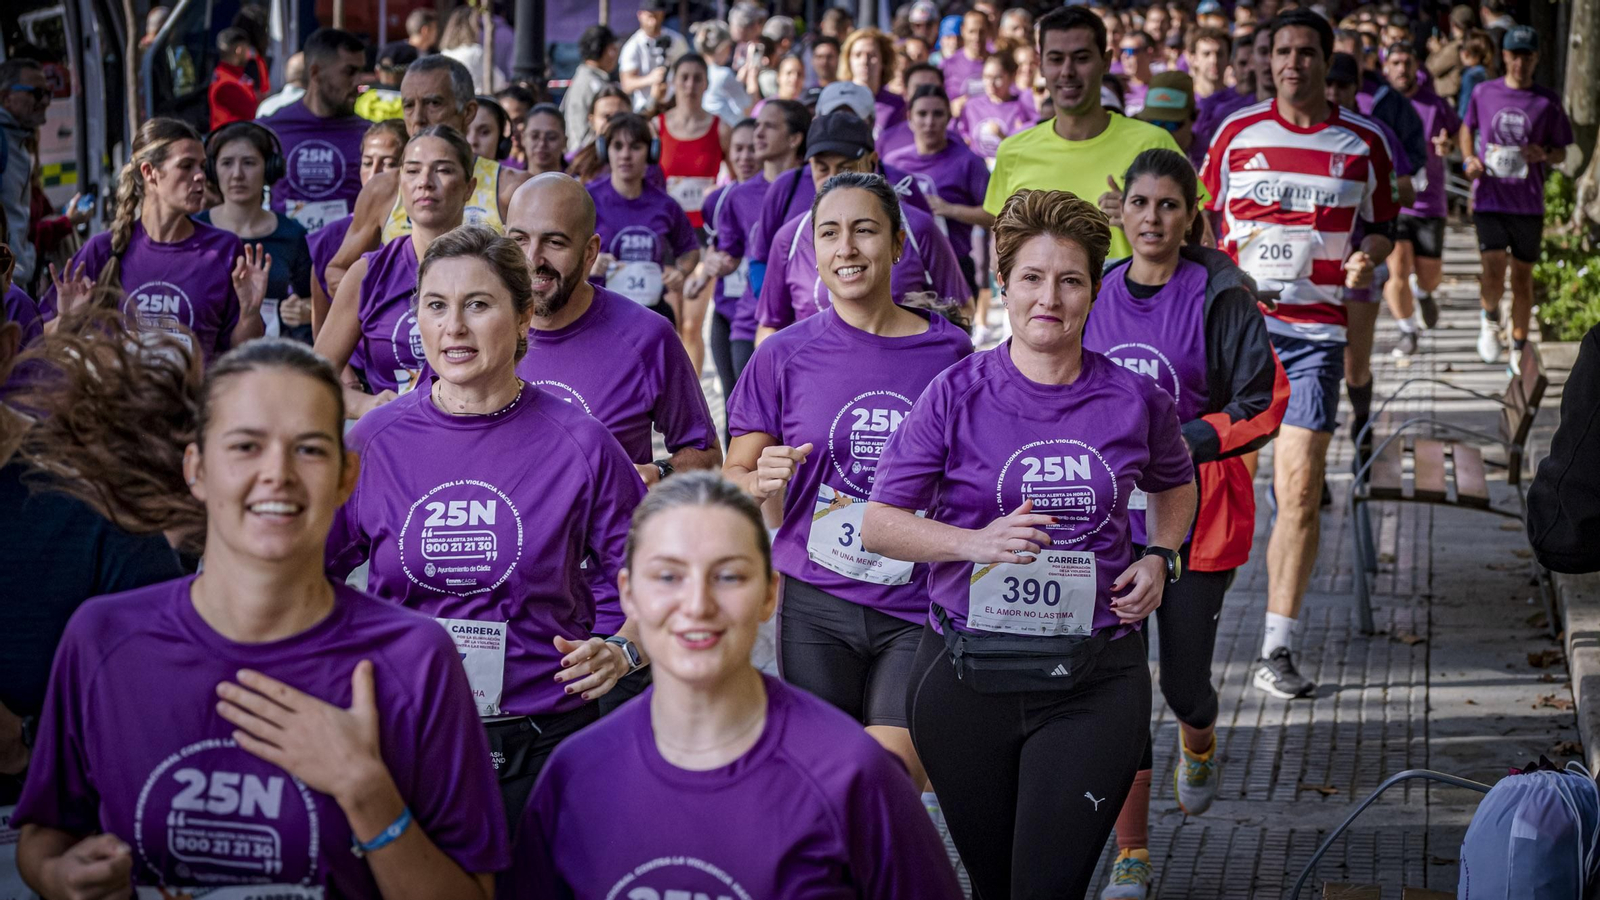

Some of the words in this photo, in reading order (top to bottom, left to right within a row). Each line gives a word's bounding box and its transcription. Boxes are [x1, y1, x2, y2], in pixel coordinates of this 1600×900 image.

[298, 148, 334, 162] 25N
[1254, 179, 1336, 204] Cámara
[307, 217, 324, 228] 54
[621, 234, 653, 248] 25N
[1259, 244, 1292, 260] 206
[628, 278, 645, 289] 34
[136, 294, 180, 314] 25N
[545, 380, 572, 392] VIOLENCIA
[572, 390, 585, 403] HACIA
[829, 400, 854, 438] INTERNACIONAL
[854, 391, 876, 402] CONTRA
[885, 391, 913, 406] VIOLENCIA
[997, 449, 1022, 493] INTERNACIONAL
[1022, 440, 1045, 450] CONTRA
[1056, 439, 1087, 448] VIOLENCIA
[1088, 445, 1103, 461] HACIA
[1102, 460, 1112, 472] LAS
[1020, 455, 1092, 482] 25N
[834, 462, 844, 477] CÁDIZ
[844, 477, 863, 493] CONTRA
[400, 494, 429, 537] INTERNACIONAL
[429, 481, 454, 495] CONTRA
[466, 480, 497, 493] VIOLENCIA
[497, 490, 512, 506] HACIA
[511, 505, 519, 517] LAS
[1051, 498, 1062, 506] 21
[1065, 498, 1075, 506] 21
[1077, 497, 1091, 505] 30
[424, 500, 496, 527] 25N
[426, 543, 449, 552] 900
[450, 542, 462, 552] 21
[464, 542, 476, 551] 21
[477, 542, 492, 550] 30
[1053, 535, 1087, 545] VIOLENCIA
[840, 552, 854, 562] UNA
[856, 557, 882, 568] MENOS
[1047, 556, 1091, 565] CARRERA
[403, 566, 418, 584] CÁDIZ
[419, 582, 446, 593] CONTRA
[457, 587, 492, 597] VIOLENCIA
[491, 562, 517, 590] MACHISTA
[1002, 576, 1061, 606] 390
[996, 609, 1021, 617] AMOR
[452, 626, 501, 636] CARRERA
[171, 768, 284, 819] 25N
[212, 838, 230, 855] 21
[232, 840, 249, 856] 21
[252, 841, 274, 858] 30
